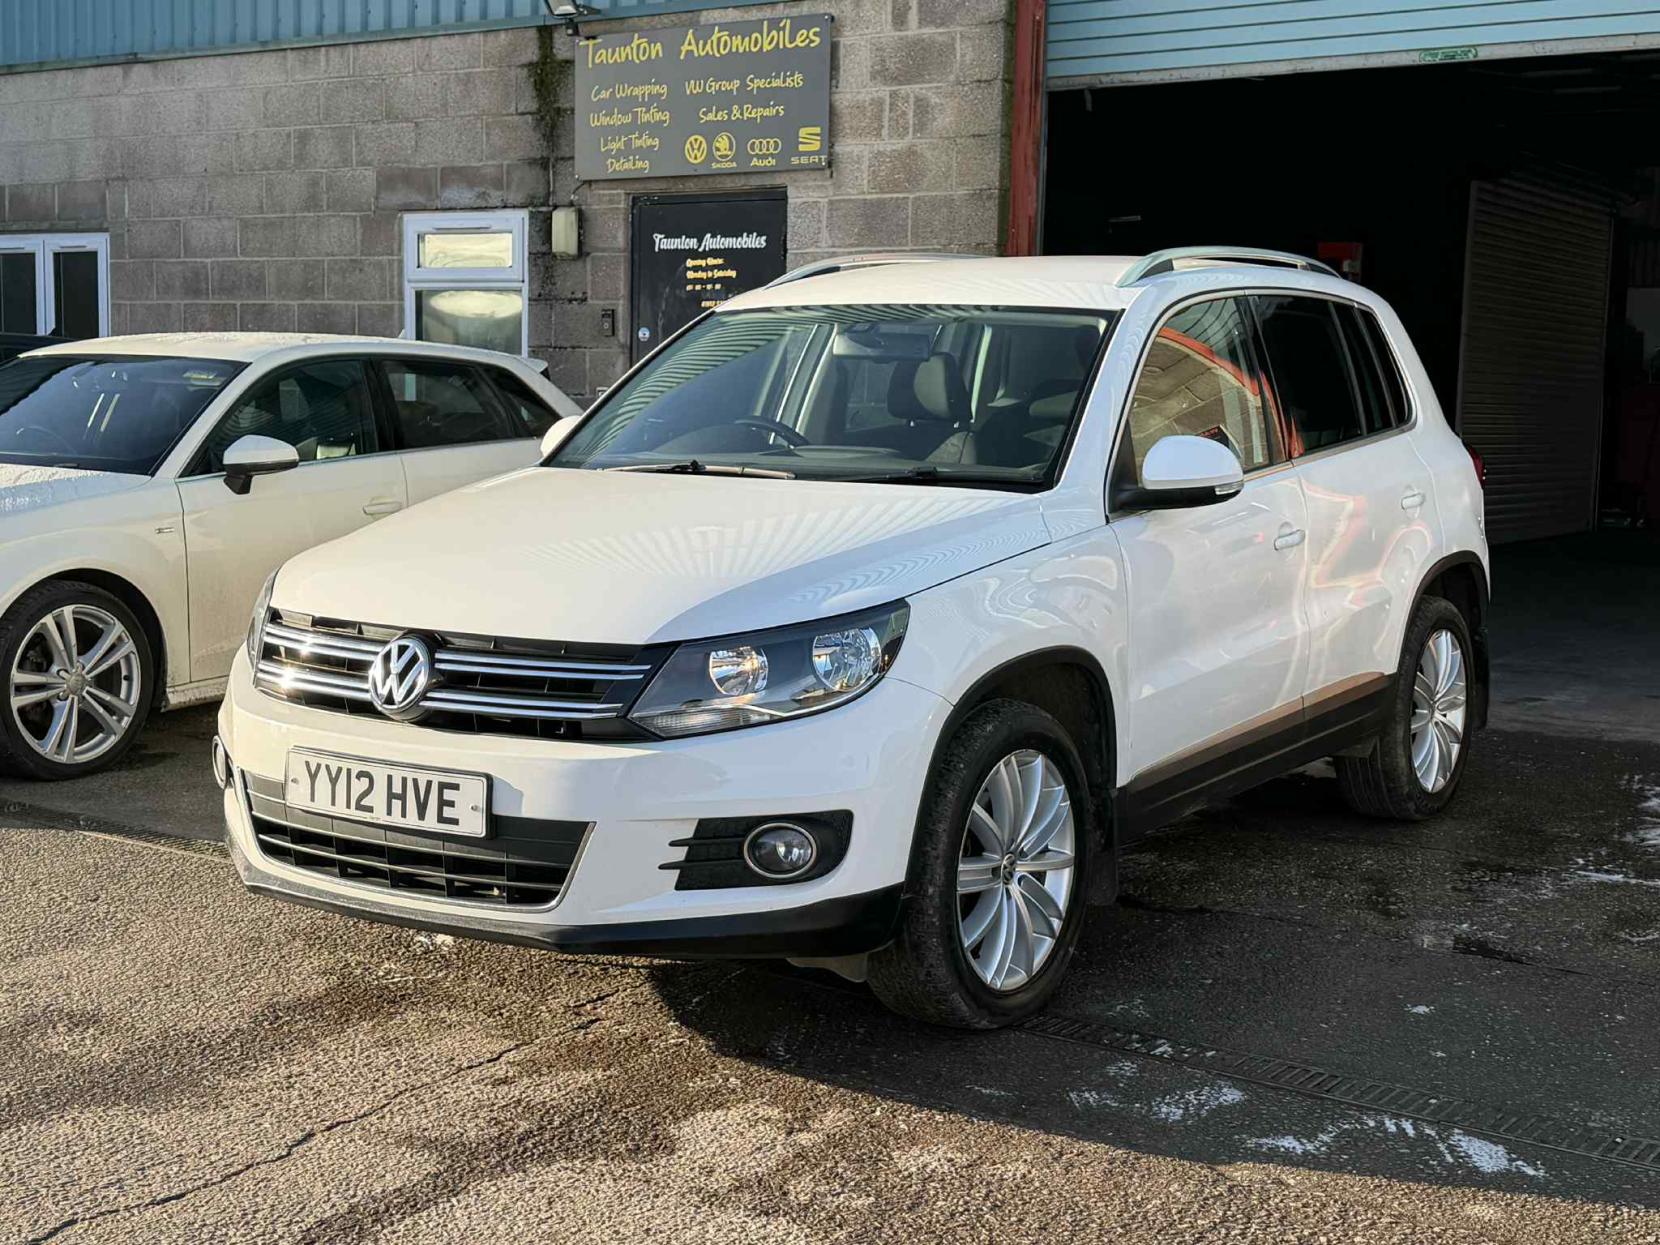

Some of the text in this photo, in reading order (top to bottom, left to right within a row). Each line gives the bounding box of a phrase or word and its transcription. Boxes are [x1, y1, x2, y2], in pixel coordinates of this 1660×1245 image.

[579, 19, 821, 68] Taunton Automobiles
[591, 79, 668, 101] Car Wrapping
[685, 71, 804, 95] VW Group Specialists
[590, 103, 670, 127] Window Tinting
[699, 101, 784, 123] Sales & Repairs
[600, 131, 660, 154] Light Tinting
[607, 155, 650, 173] Detailing
[751, 157, 776, 167] Audi
[791, 155, 828, 165] SEAT
[653, 232, 767, 252] Taunton Automobiles
[305, 760, 461, 826] YY12 HVE
